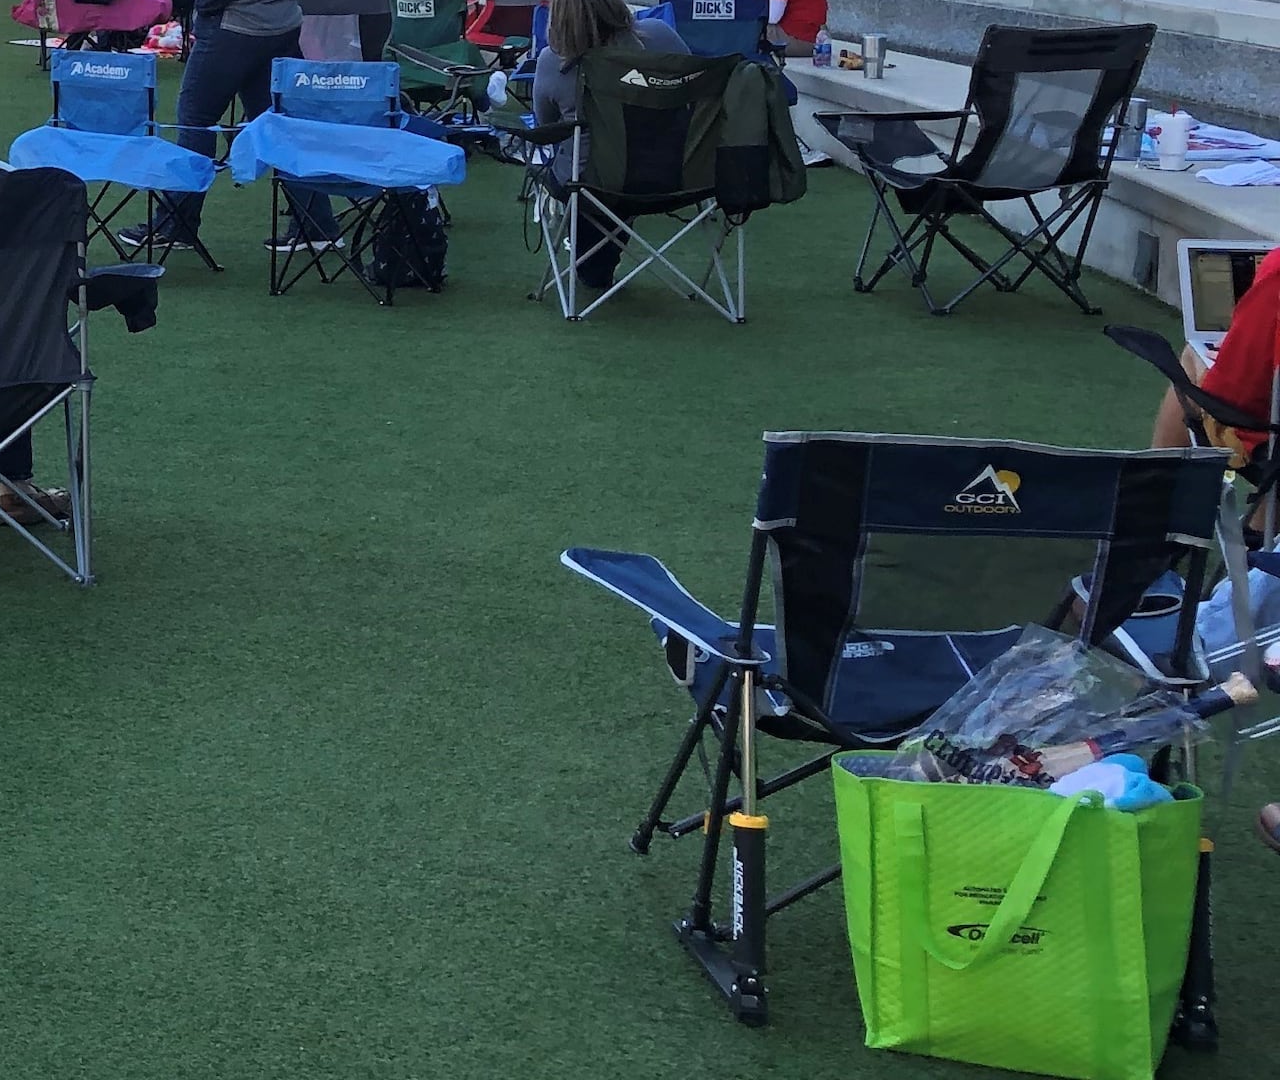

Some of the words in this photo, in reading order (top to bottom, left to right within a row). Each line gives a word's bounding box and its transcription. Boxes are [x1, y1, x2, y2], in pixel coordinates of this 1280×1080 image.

[84, 62, 130, 79] Academy
[311, 73, 368, 89] Academy
[955, 493, 1007, 505] GCI
[944, 505, 1016, 514] OUTDOOR
[735, 859, 744, 934] KICKBACK
